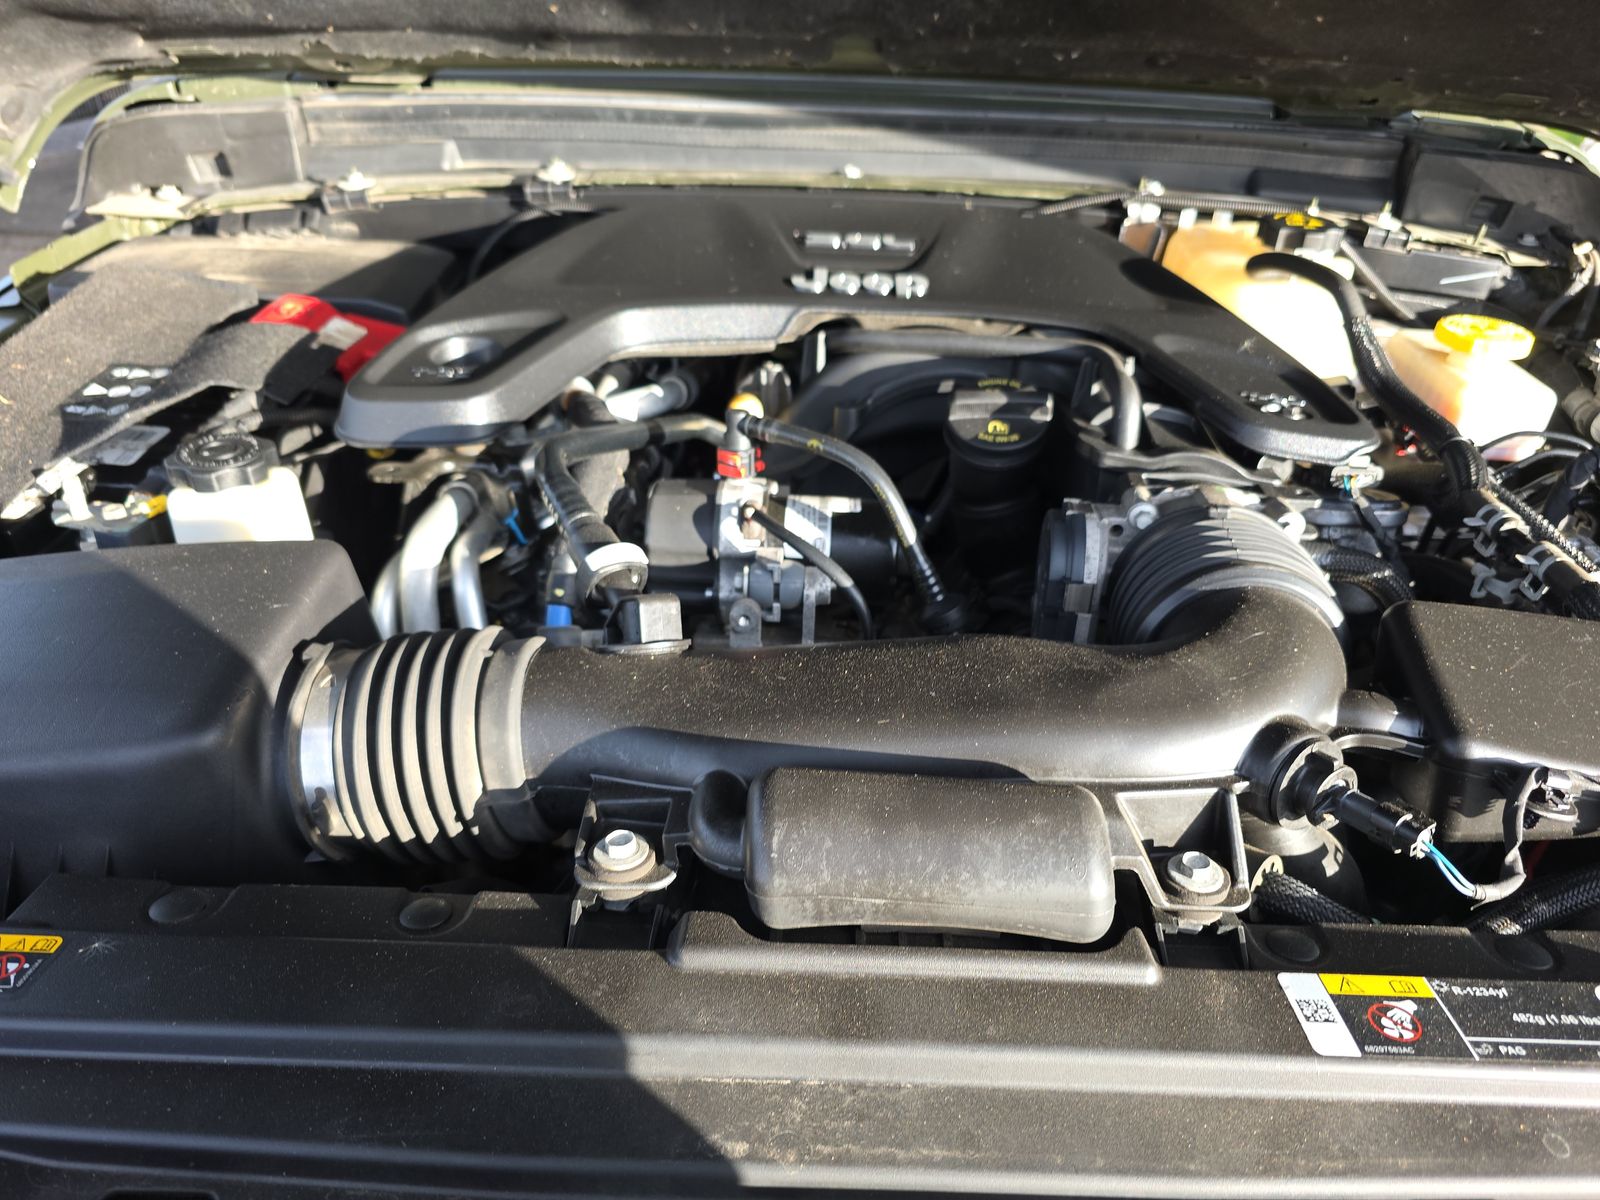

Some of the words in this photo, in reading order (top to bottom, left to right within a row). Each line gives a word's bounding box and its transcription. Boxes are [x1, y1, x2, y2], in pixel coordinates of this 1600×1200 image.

[790, 265, 930, 299] Jeep
[1451, 985, 1509, 999] R-1234yf
[1512, 1012, 1546, 1026] 482g
[1498, 1045, 1527, 1056] PAG
